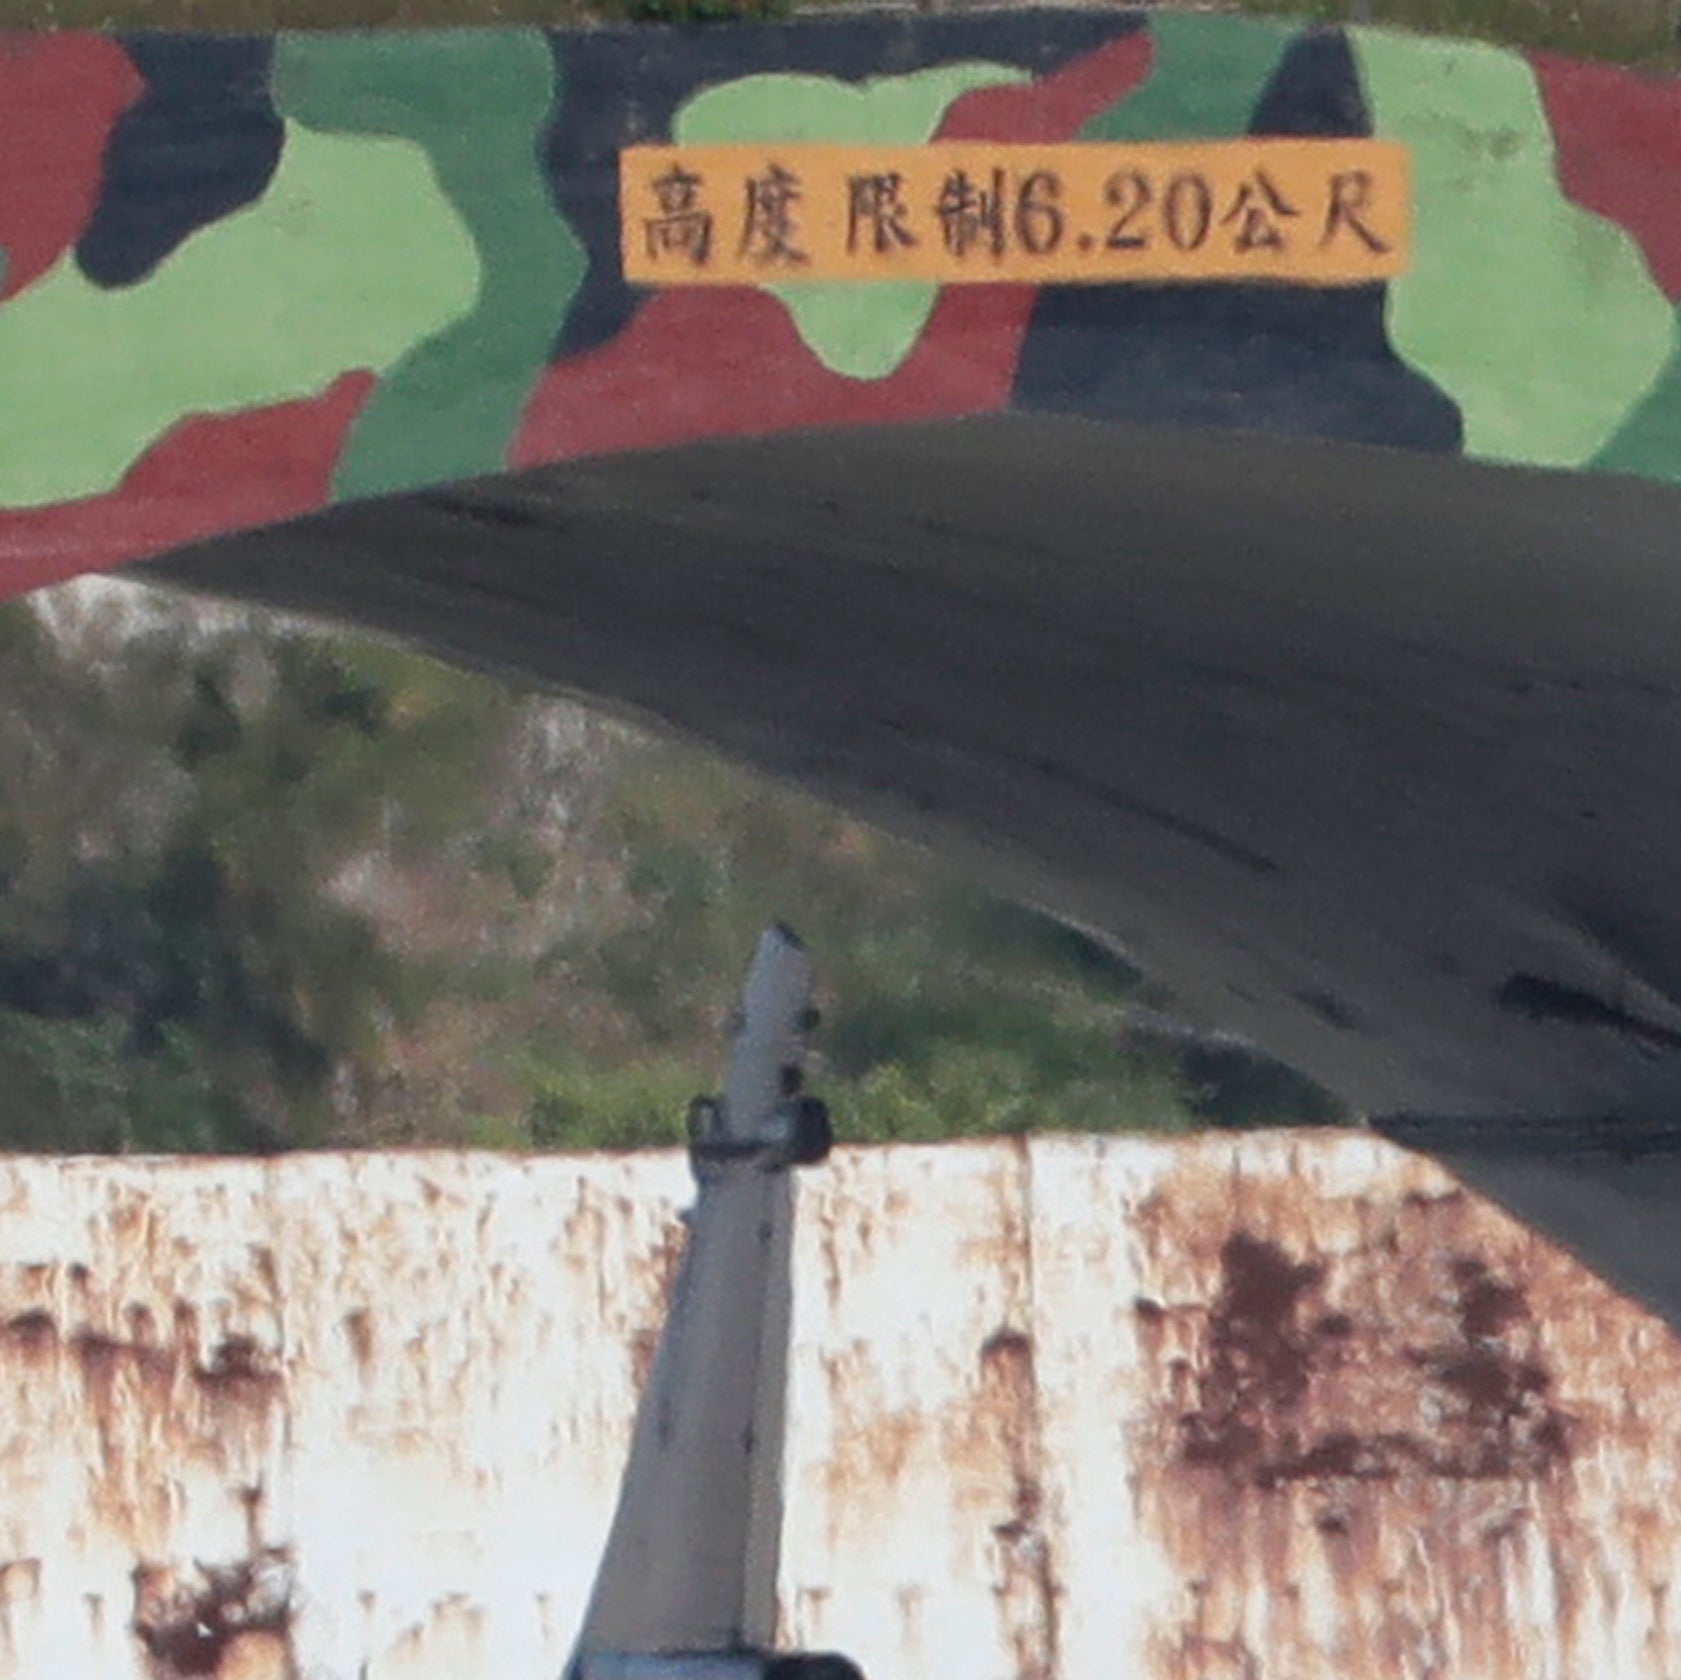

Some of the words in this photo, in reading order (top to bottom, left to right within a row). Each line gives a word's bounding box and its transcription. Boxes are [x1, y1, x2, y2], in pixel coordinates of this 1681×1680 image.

[643, 162, 1391, 266] 高度限制6.20公尺
